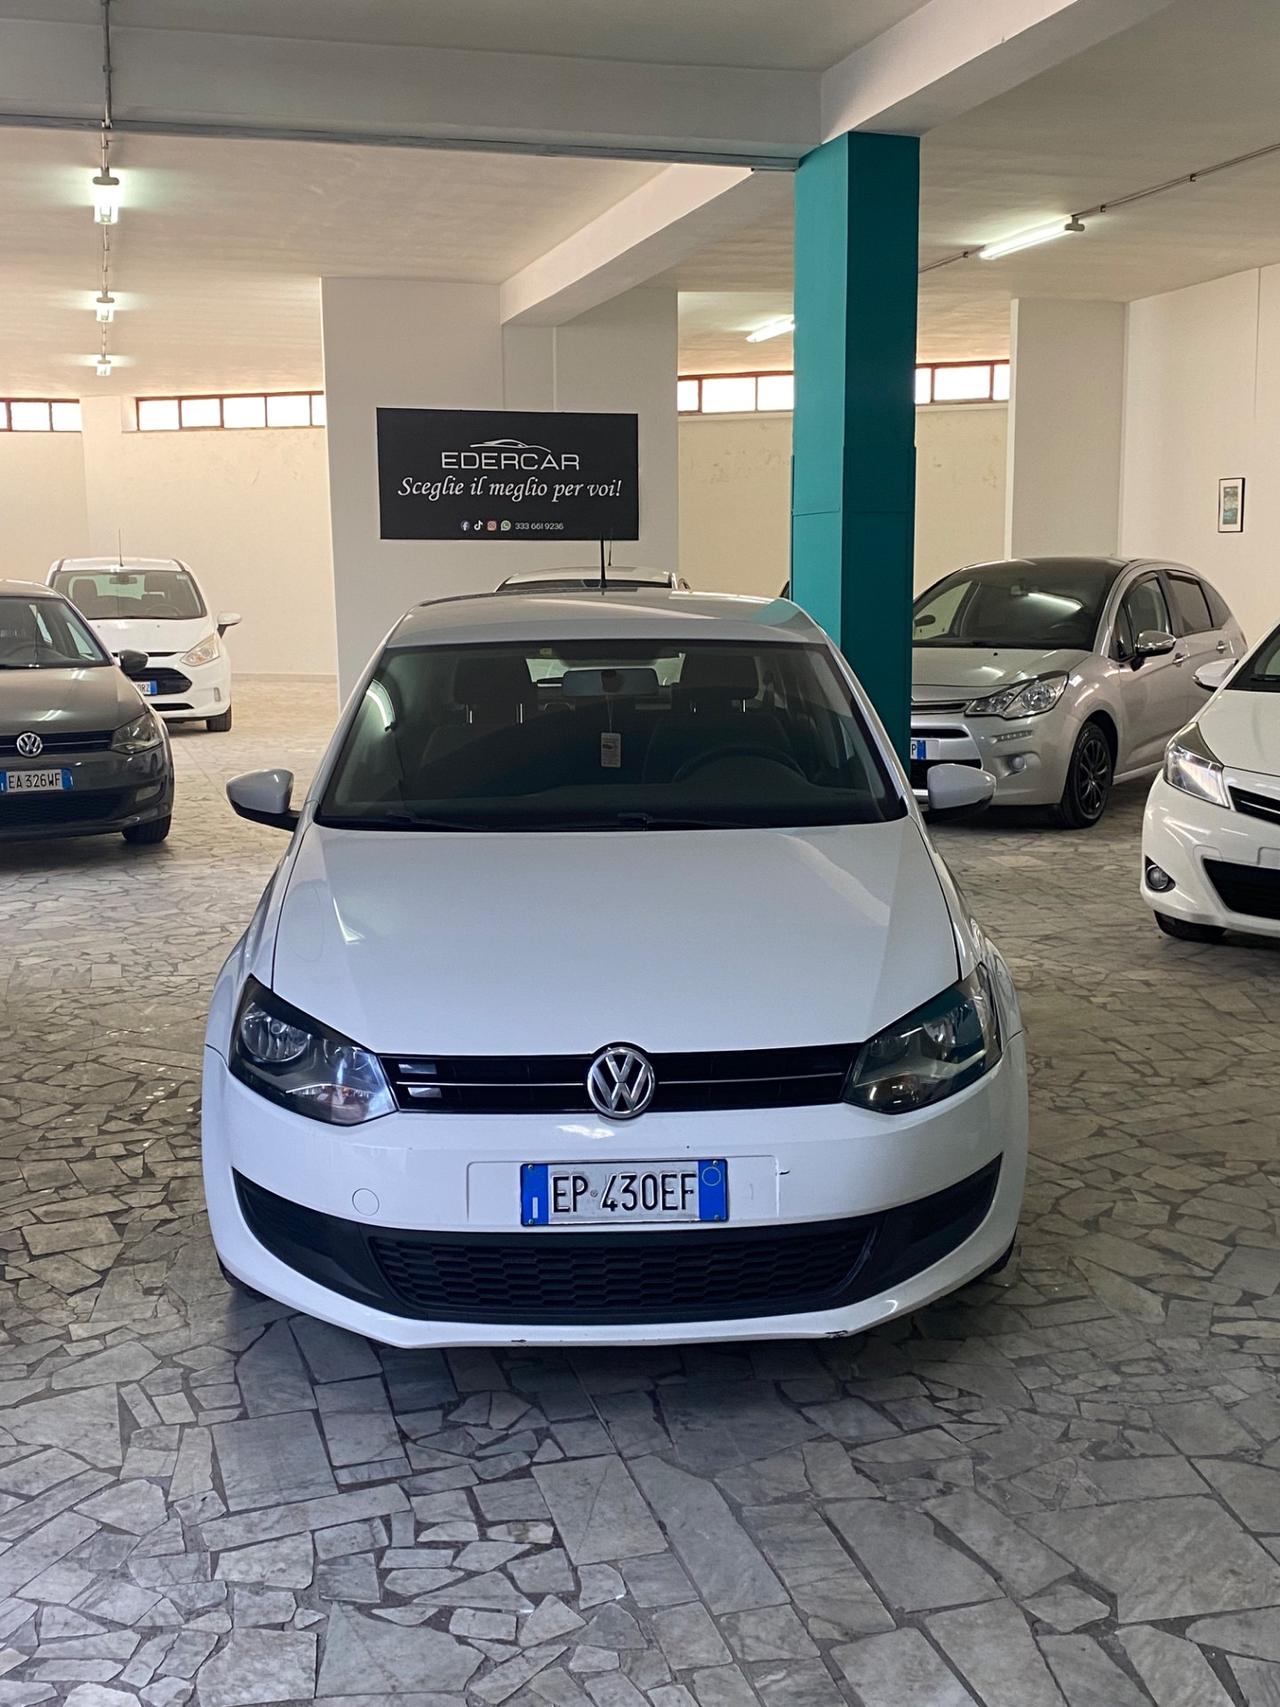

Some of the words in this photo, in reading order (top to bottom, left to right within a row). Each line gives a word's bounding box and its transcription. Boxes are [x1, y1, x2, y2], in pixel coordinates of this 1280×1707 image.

[441, 451, 580, 470] EDERCAR
[397, 475, 465, 501] Sceglie
[470, 476, 488, 496] il
[489, 477, 548, 502] meglio
[552, 483, 584, 503] per
[587, 480, 622, 497] voi!
[514, 522, 530, 530] 333
[530, 522, 544, 530] 661
[544, 522, 564, 530] 9236
[8, 775, 23, 789] EA
[25, 772, 60, 788] 326WF
[552, 1175, 588, 1213] EP
[601, 1172, 697, 1212] 430EF
